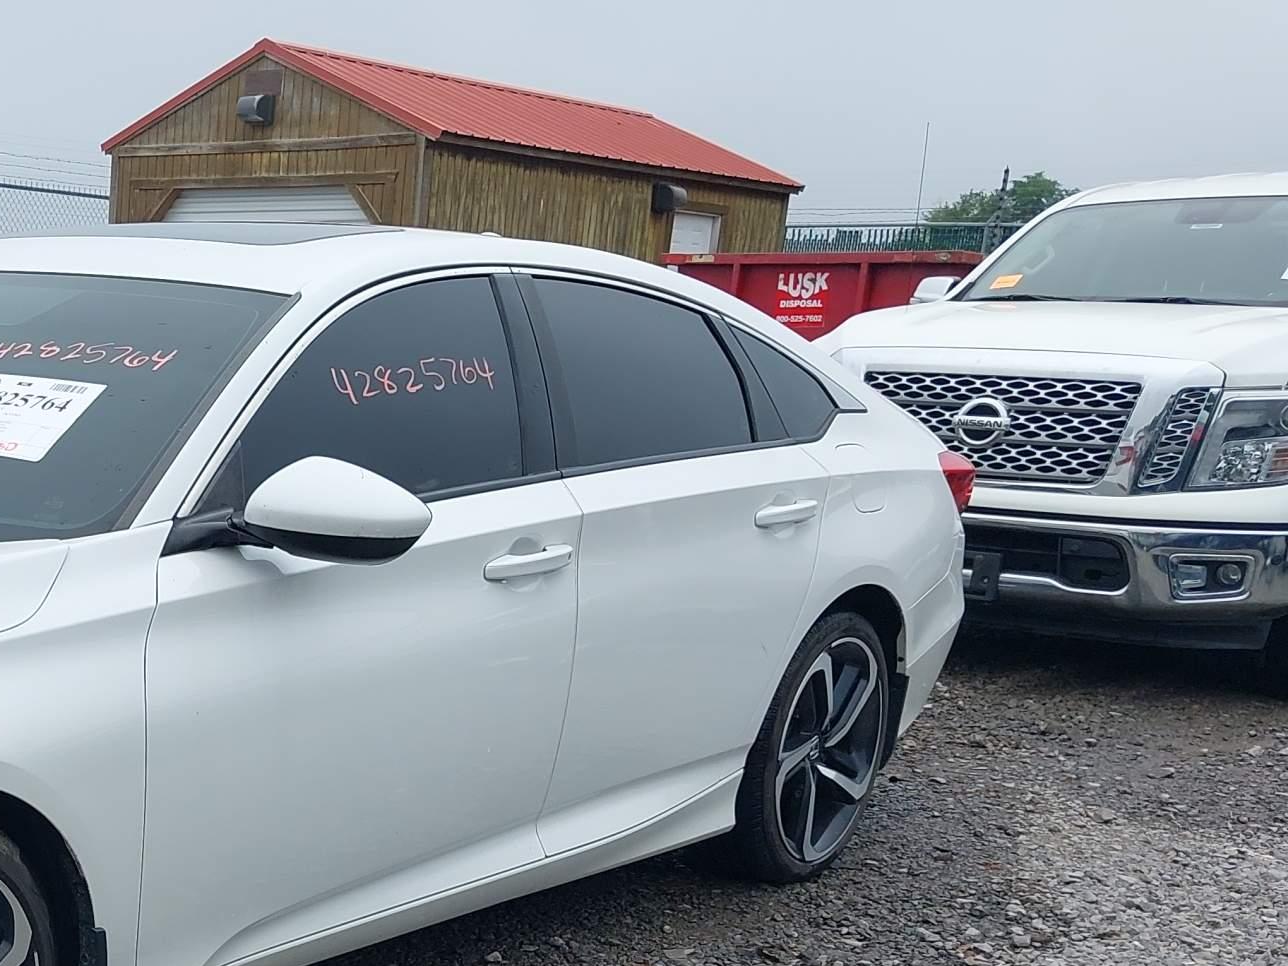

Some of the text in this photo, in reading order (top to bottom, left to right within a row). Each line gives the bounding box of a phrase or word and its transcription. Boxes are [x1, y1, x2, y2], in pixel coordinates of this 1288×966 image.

[777, 272, 831, 299] LUSK
[779, 299, 823, 308] DISPOSAL
[330, 357, 495, 405] 42825764
[956, 418, 1003, 428] NISSAN
